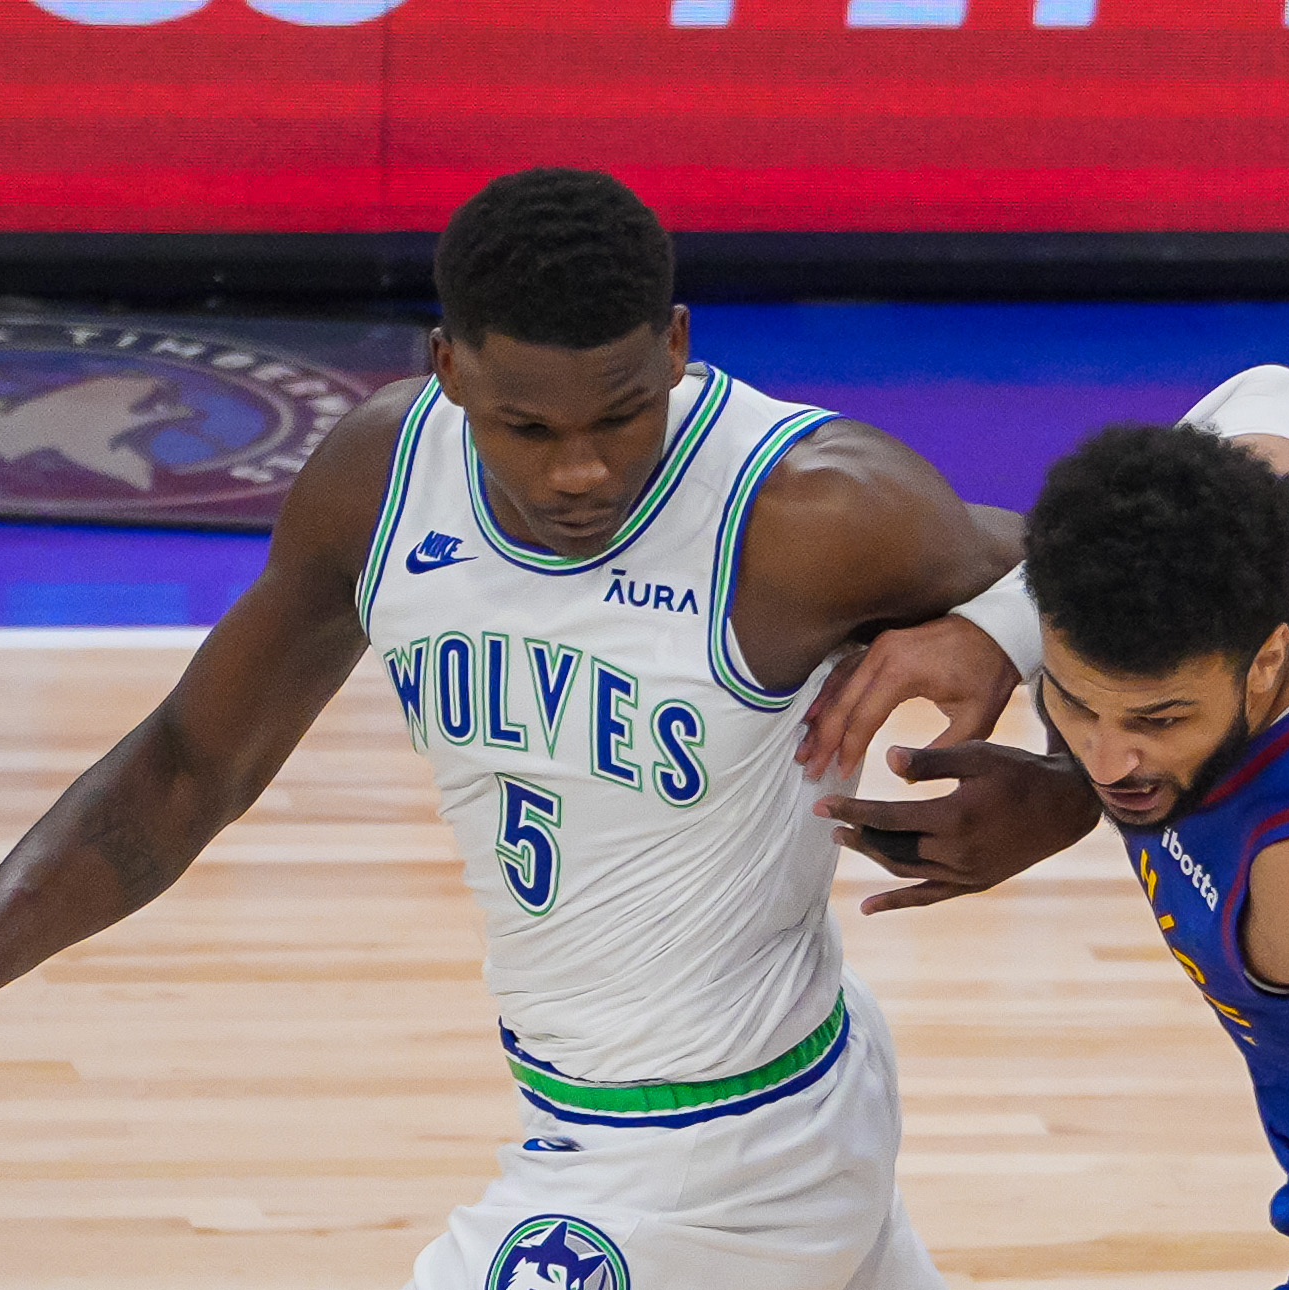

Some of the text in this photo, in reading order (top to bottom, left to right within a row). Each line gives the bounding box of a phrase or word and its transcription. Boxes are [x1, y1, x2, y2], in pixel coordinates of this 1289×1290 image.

[418, 530, 463, 559] NIKE
[384, 631, 708, 808] WOLVES
[495, 772, 561, 916] 5
[1161, 826, 1219, 912] ibotta
